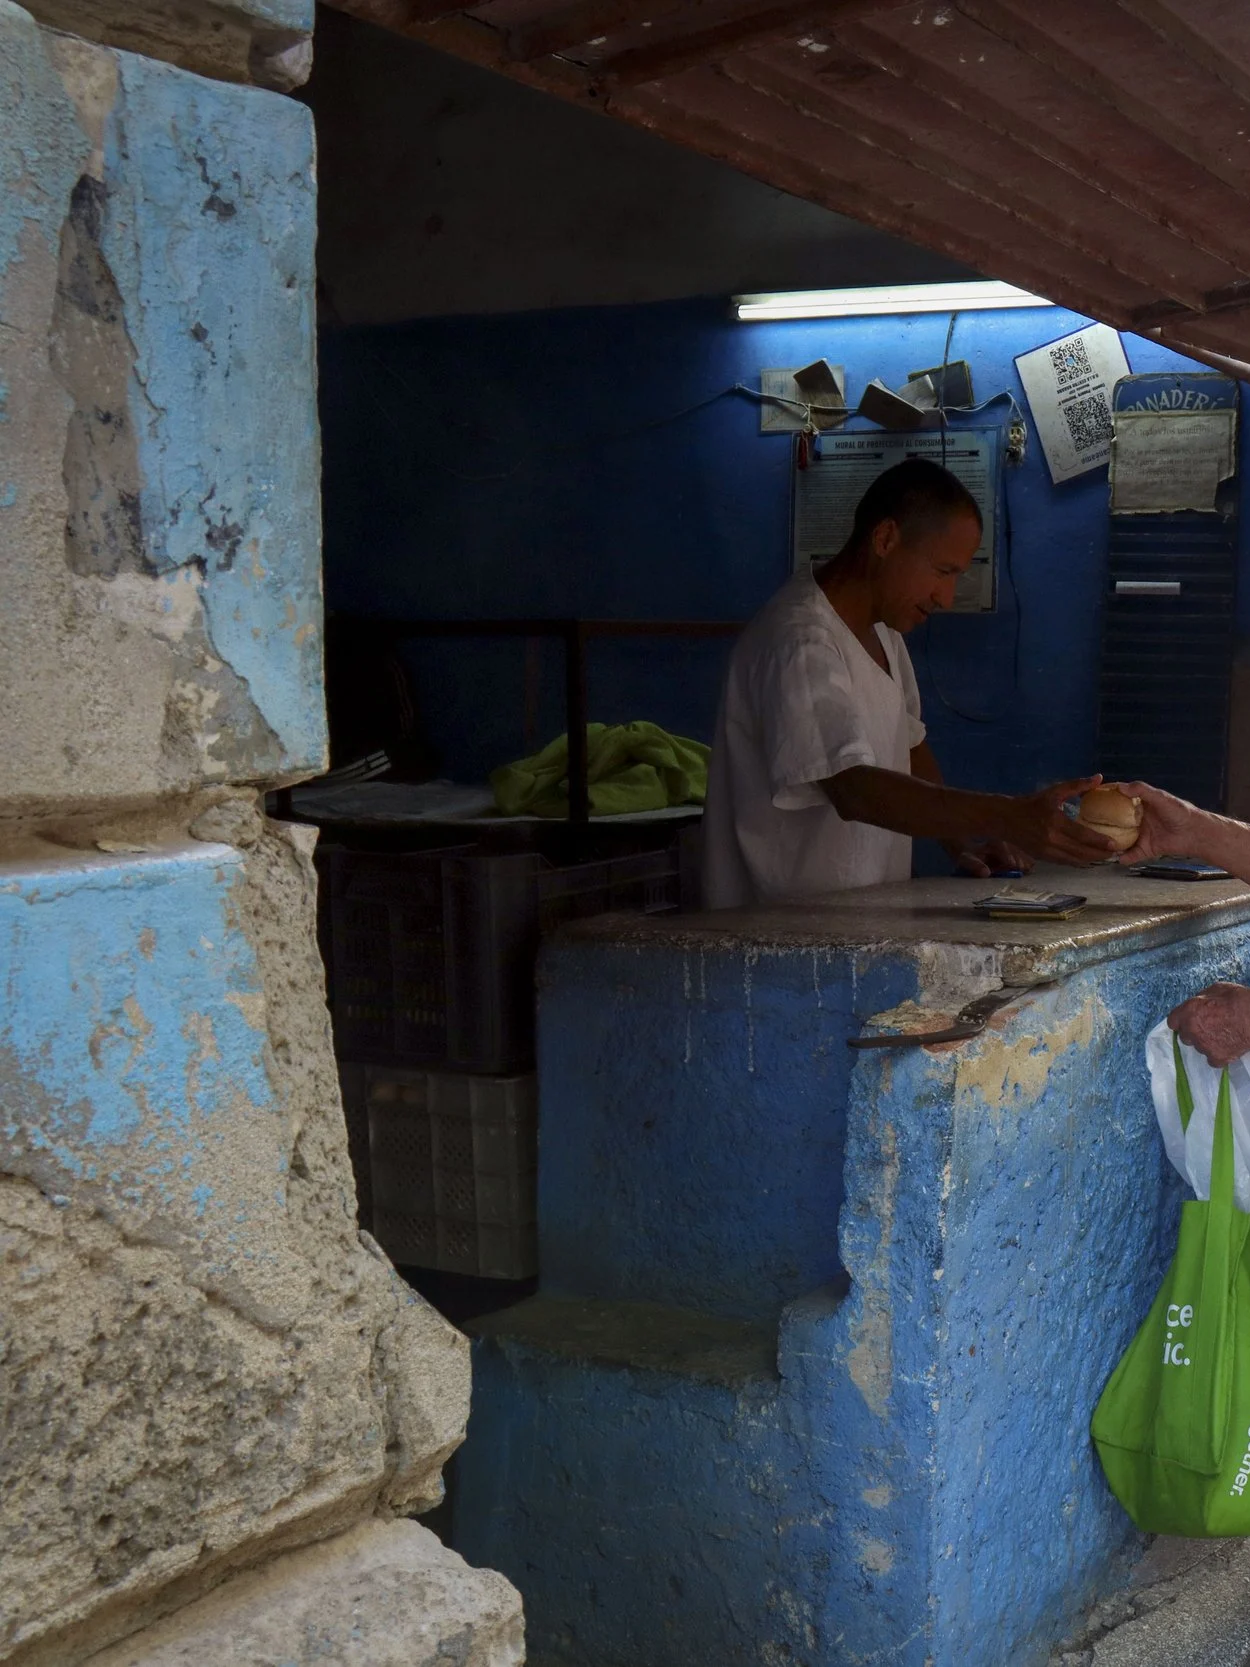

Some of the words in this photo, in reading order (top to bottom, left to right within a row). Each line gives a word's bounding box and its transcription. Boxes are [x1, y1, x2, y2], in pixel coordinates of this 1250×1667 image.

[1126, 389, 1224, 412] ANADERÍ
[835, 441, 856, 449] MURAL
[866, 440, 904, 448] PROTECCN
[906, 439, 913, 447] AL
[915, 438, 956, 447] CONSUMOR
[1163, 1332, 1191, 1366] ic.
